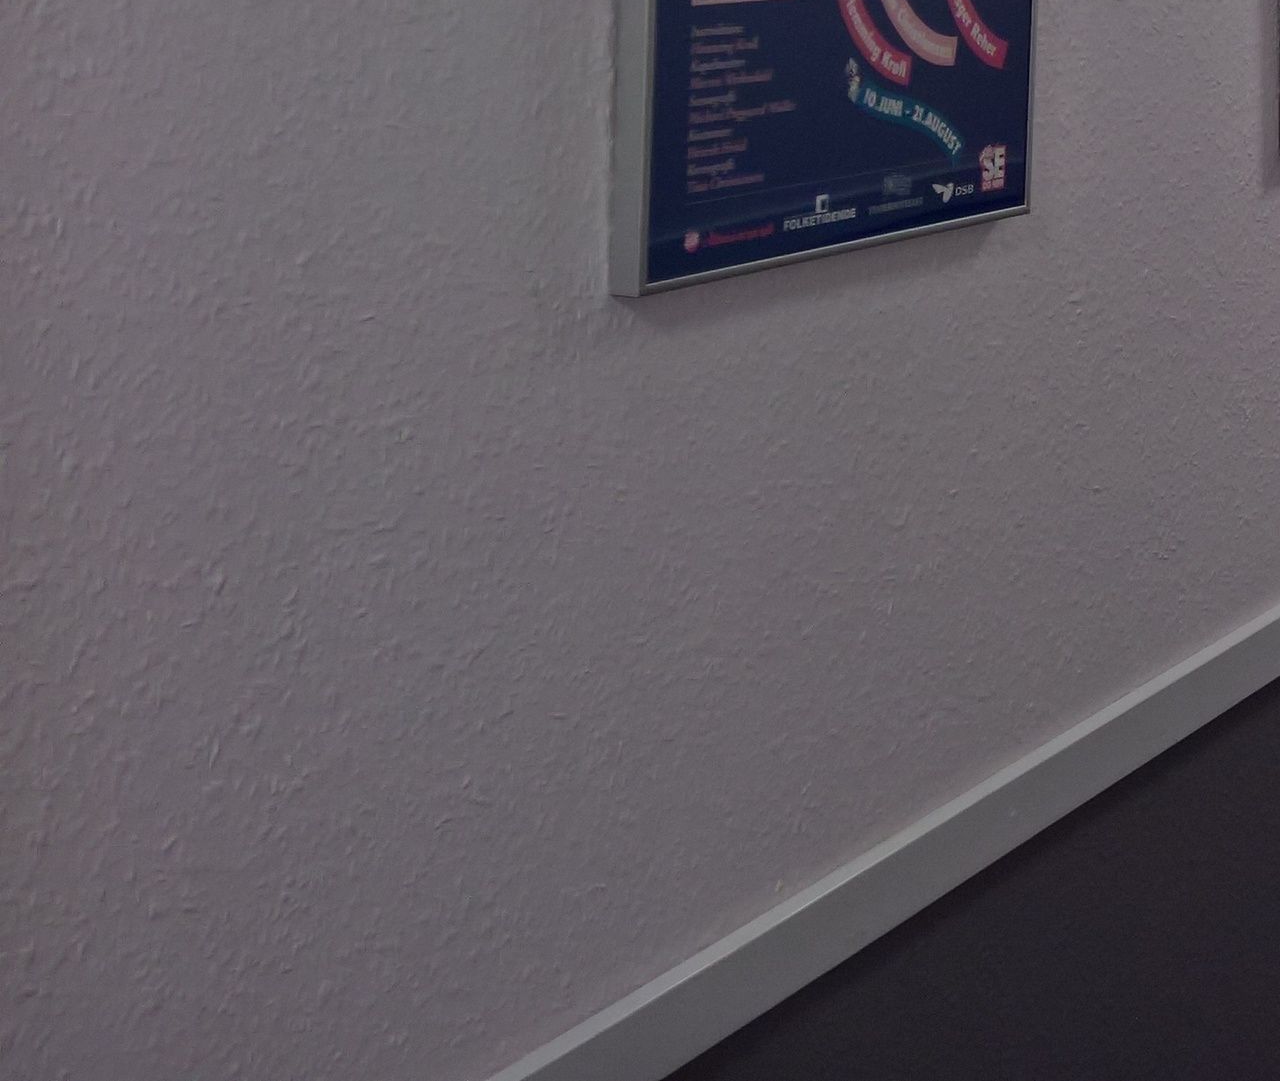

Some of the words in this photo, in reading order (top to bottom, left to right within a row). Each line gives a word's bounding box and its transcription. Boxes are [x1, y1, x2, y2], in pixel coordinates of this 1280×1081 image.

[969, 21, 998, 57] Reher
[955, 184, 974, 197] DSB
[783, 208, 857, 231] FOLKETIDENDE
